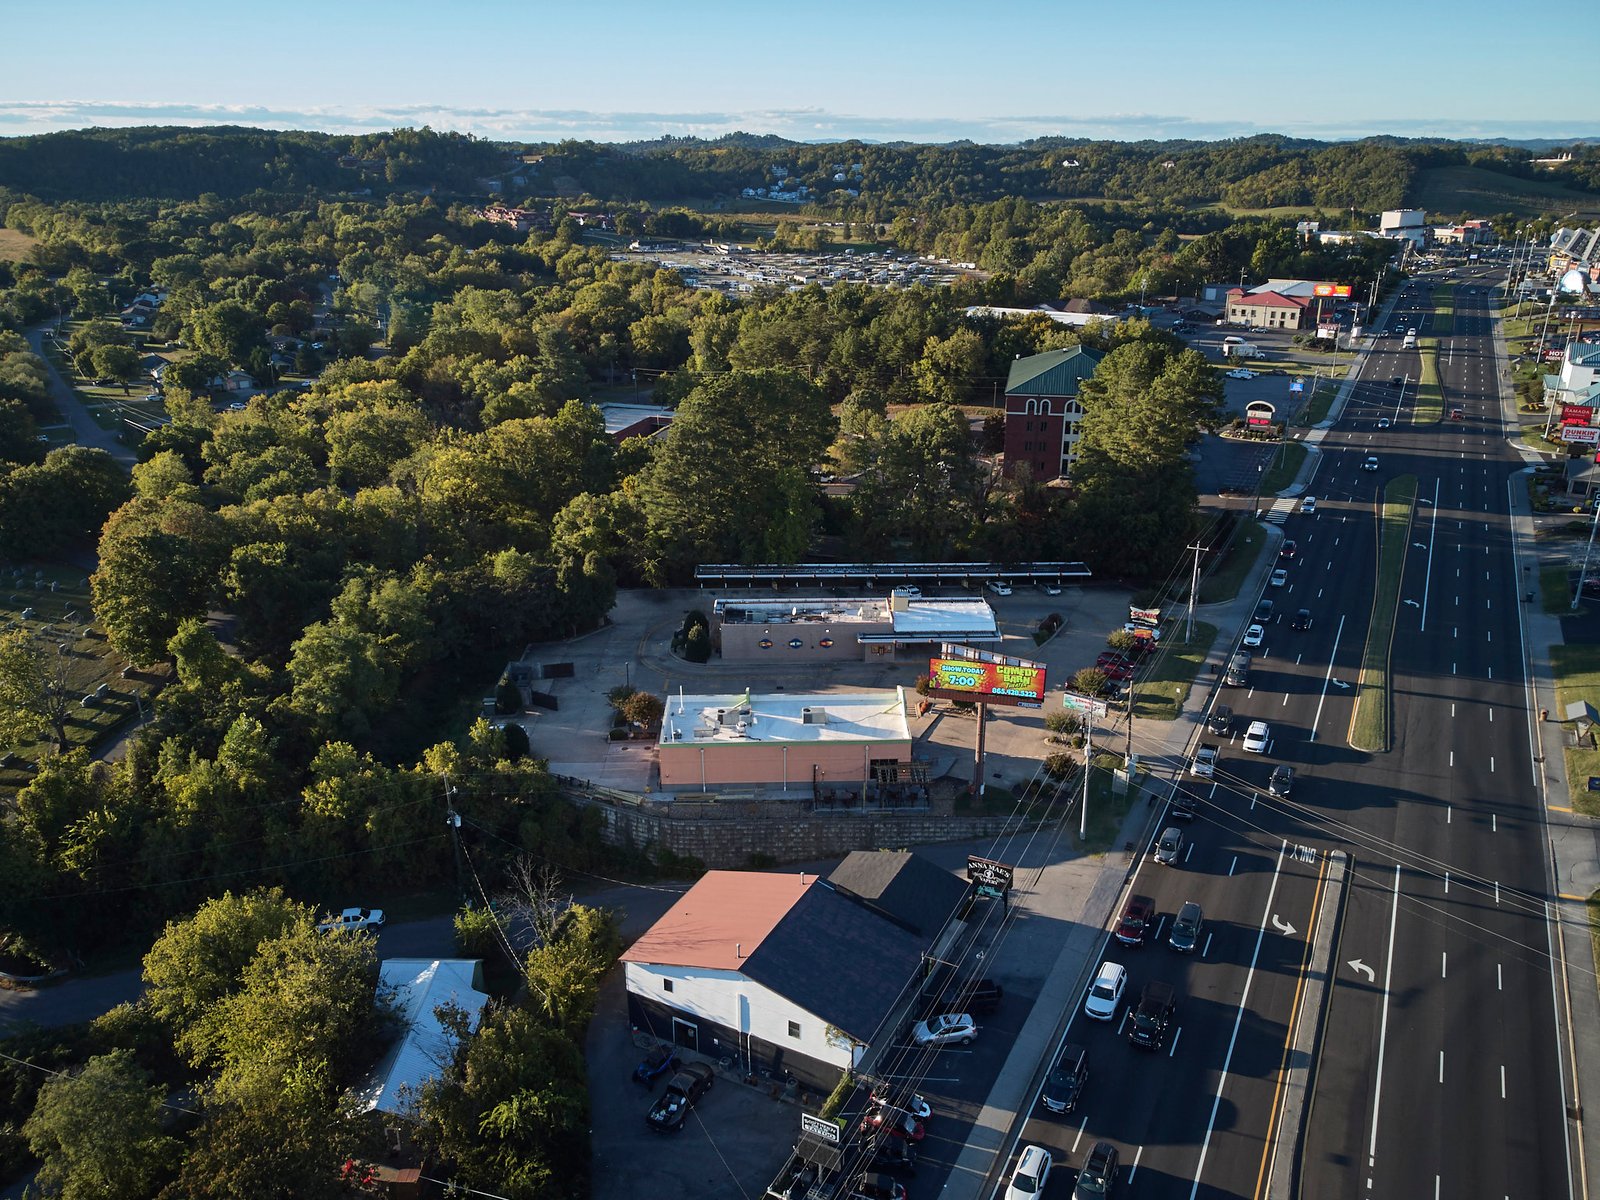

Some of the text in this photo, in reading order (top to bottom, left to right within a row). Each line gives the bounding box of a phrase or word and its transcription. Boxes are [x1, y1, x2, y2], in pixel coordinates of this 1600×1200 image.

[1565, 429, 1597, 437] DUNKIN'
[1132, 611, 1158, 619] SONIC
[941, 664, 986, 675] SHOW TODAY
[996, 665, 1038, 677] COMEDY
[949, 675, 976, 687] 7:00
[1003, 675, 1031, 685] BARN
[1290, 843, 1317, 864] ONLY
[988, 864, 1010, 878] MAE'S
